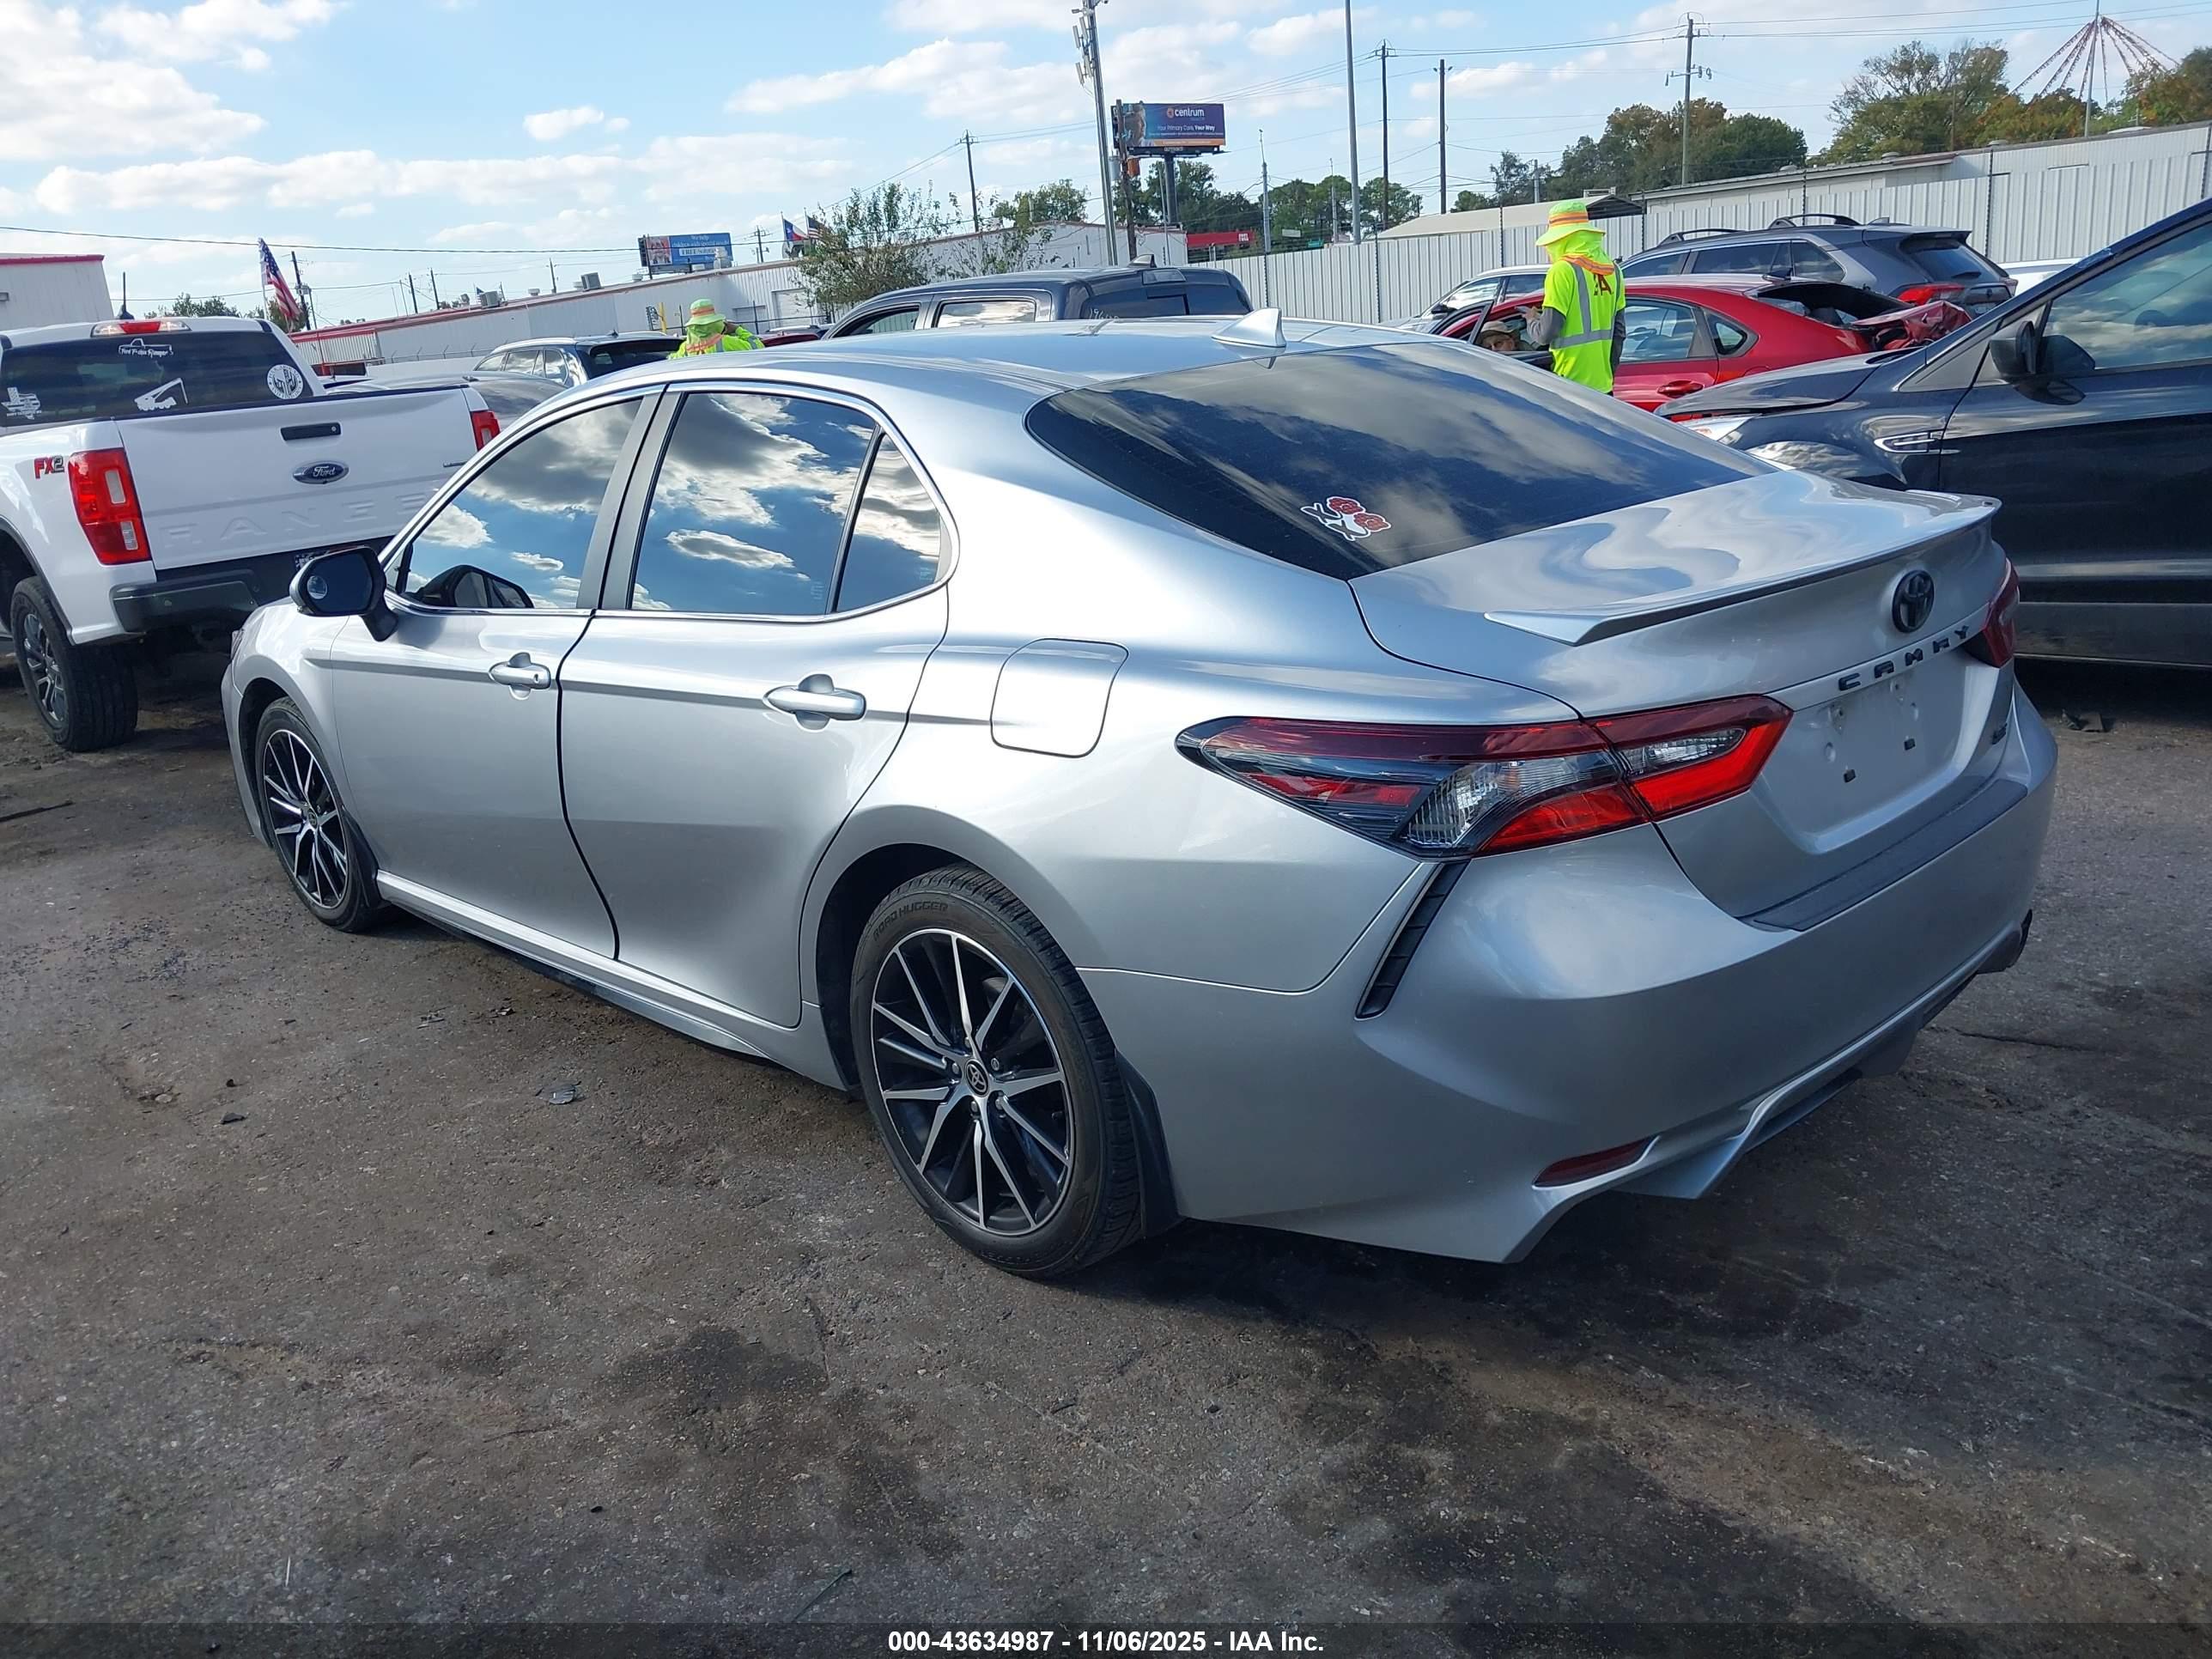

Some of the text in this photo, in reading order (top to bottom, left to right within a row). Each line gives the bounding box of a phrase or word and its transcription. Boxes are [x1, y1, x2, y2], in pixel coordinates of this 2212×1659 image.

[1175, 107, 1205, 117] centrum
[34, 455, 64, 479] FX2
[313, 465, 336, 477] Ford
[1838, 625, 1970, 692] CAMRY
[898, 901, 949, 918] HUGGER
